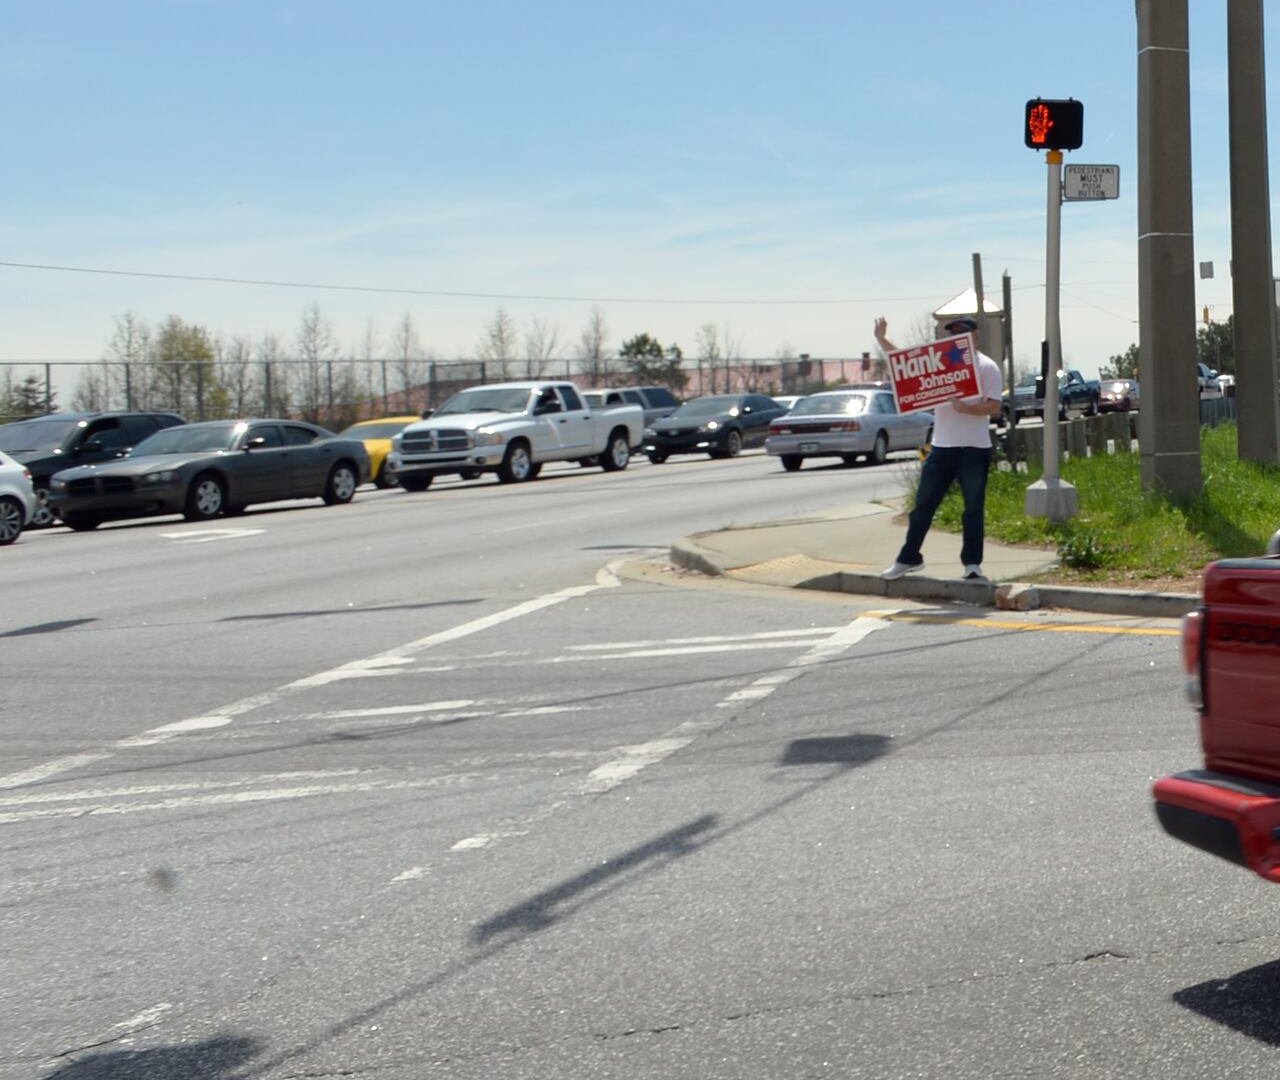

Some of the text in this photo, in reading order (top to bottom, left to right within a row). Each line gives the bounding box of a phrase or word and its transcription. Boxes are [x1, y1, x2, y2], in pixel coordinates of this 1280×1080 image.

[1080, 174, 1103, 183] MUST
[891, 346, 946, 381] Hank
[918, 368, 970, 391] Johnson
[915, 384, 957, 400] CONGRESS
